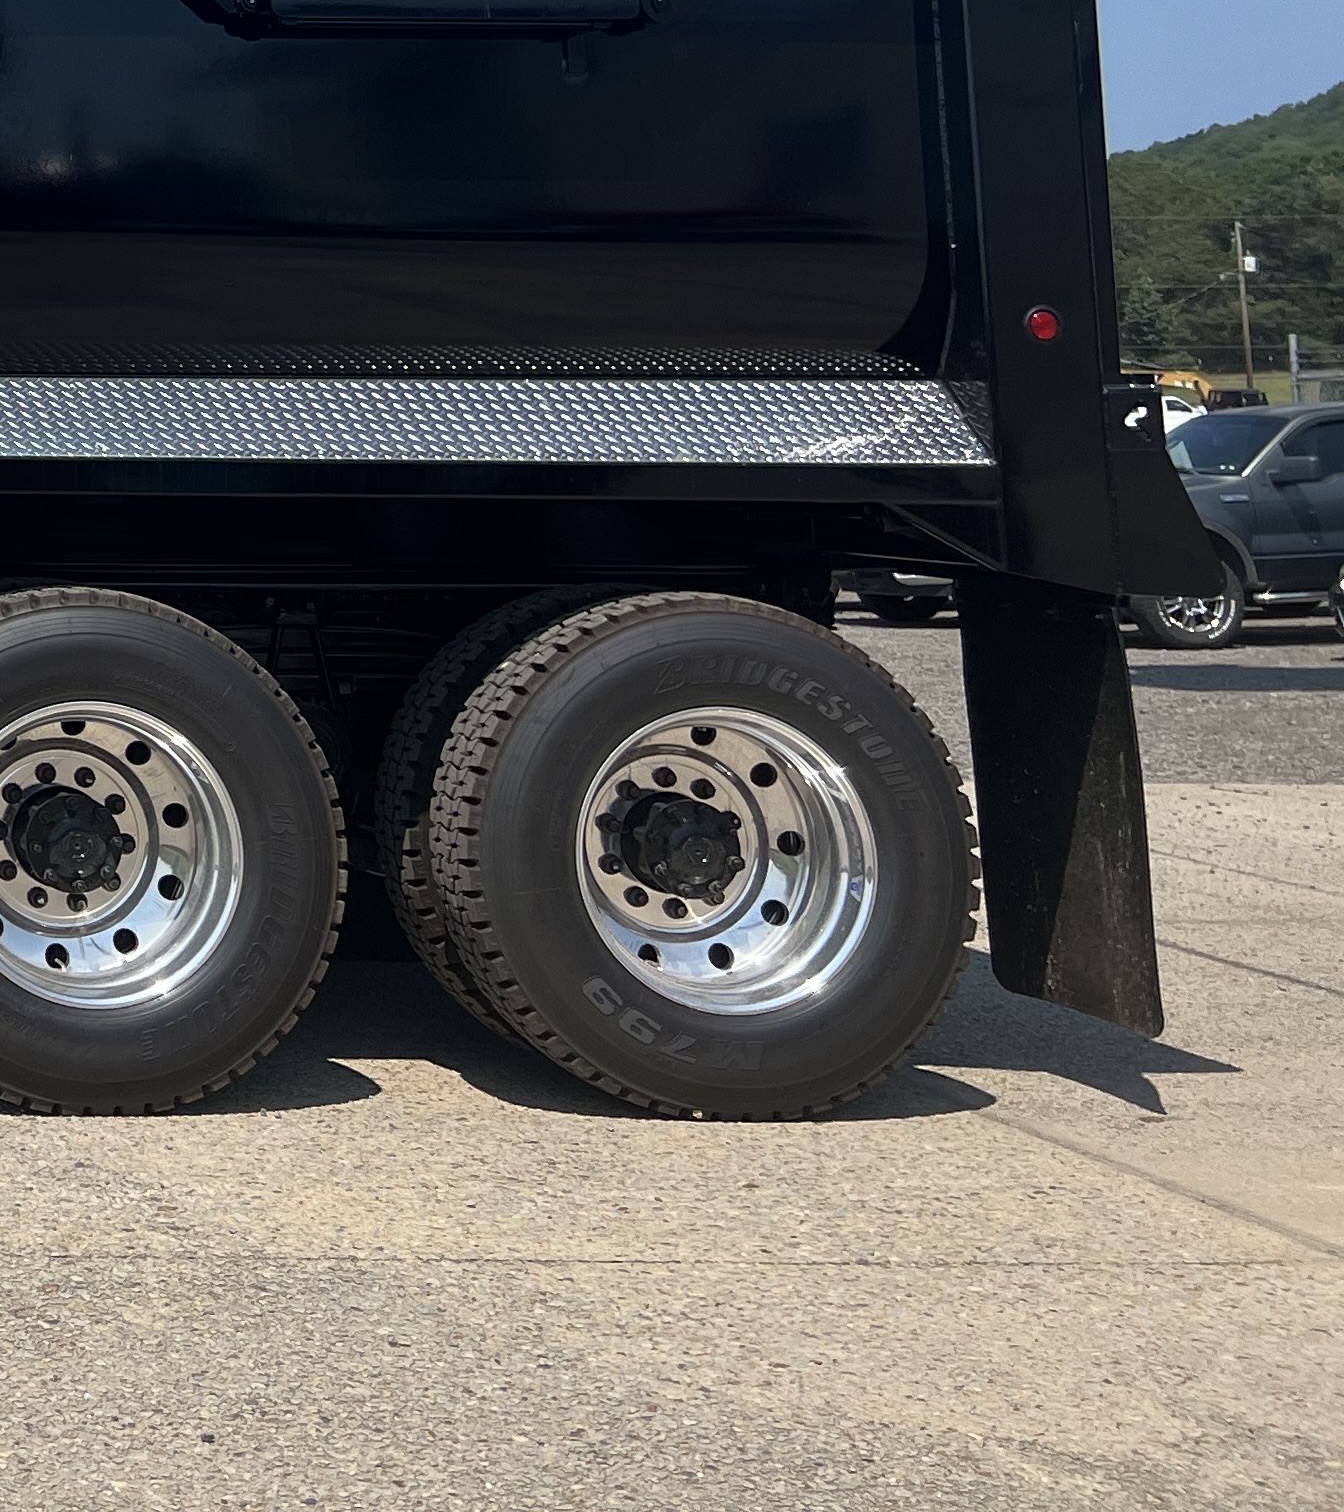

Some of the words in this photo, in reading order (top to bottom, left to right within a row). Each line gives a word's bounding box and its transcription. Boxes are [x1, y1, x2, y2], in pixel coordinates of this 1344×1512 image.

[653, 654, 925, 811] BRIDGESTONE
[141, 803, 300, 1061] BRIDGESTONE
[581, 975, 765, 1071] M799
